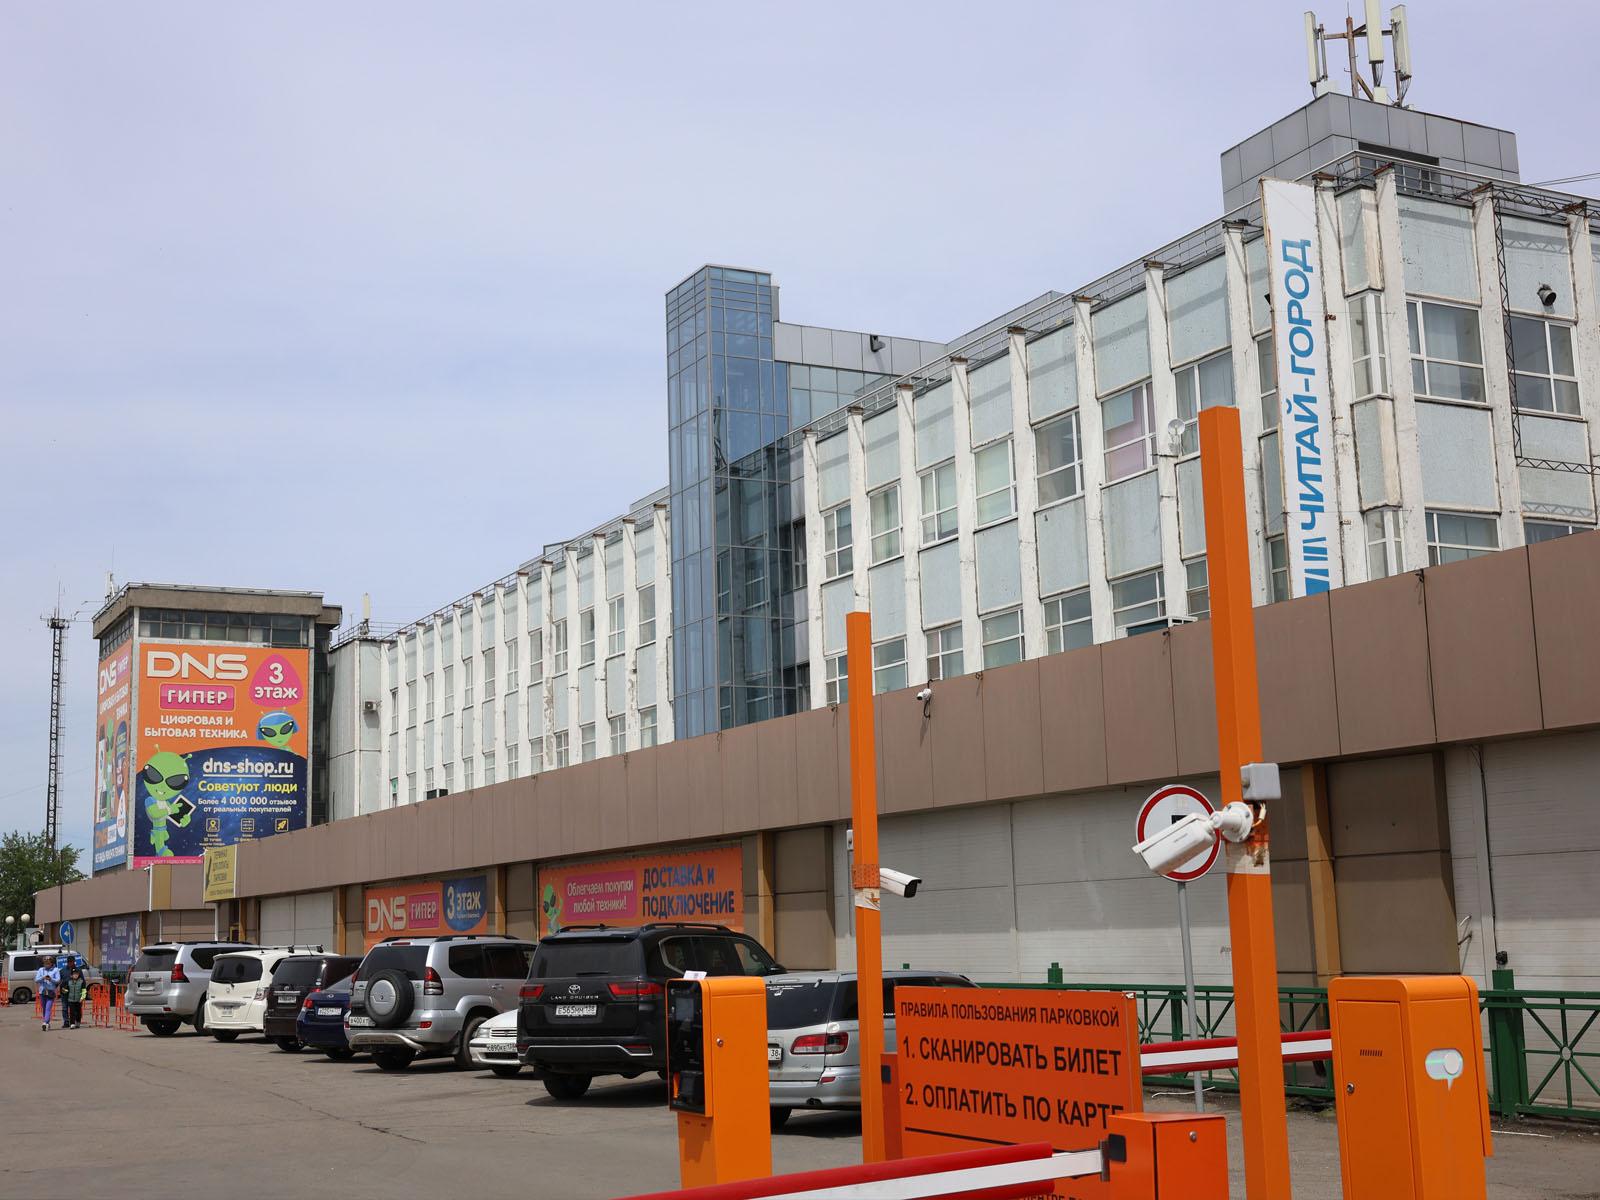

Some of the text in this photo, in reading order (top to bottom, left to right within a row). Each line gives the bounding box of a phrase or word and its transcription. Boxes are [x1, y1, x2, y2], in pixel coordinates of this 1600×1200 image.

[1281, 238, 1325, 531] ЧИТАЙ-ГОРОД
[146, 650, 249, 680] DNS
[268, 662, 284, 685] 3
[99, 660, 117, 695] DNS
[167, 689, 229, 705] ГИПЕР
[254, 686, 298, 699] этаж
[160, 715, 233, 726] ЦИФРОВАЯ И
[144, 727, 248, 739] БЫТОВАЯ ТЕХНИКА
[202, 757, 294, 777] dns-shop.ru
[198, 780, 298, 794] Советуют люди
[213, 806, 247, 814] реальных
[248, 806, 292, 814] покупателей
[221, 797, 227, 805] 4
[230, 796, 247, 805] 000
[250, 796, 268, 805] 000
[604, 879, 634, 896] покупки
[642, 863, 704, 892] ДОСТАВКА
[411, 901, 437, 920] ГИПЕР
[447, 886, 482, 920] 3 этаж
[573, 895, 628, 913] любой техники!
[642, 890, 735, 920] ПОДКЛЮЧЕНИЕ
[368, 896, 407, 932] DNS
[901, 1002, 1120, 1028] ПРАВИЛА ПОЛЬЗОВАНИЯ ПАРКОВКОЙ
[903, 1036, 1121, 1076] 1. СКАНИРОВАТЬ БИЛЕТ
[905, 1083, 919, 1105] 2.
[922, 1084, 1018, 1118] ОПЛАТИТЬ
[1022, 1095, 1052, 1122] ПО
